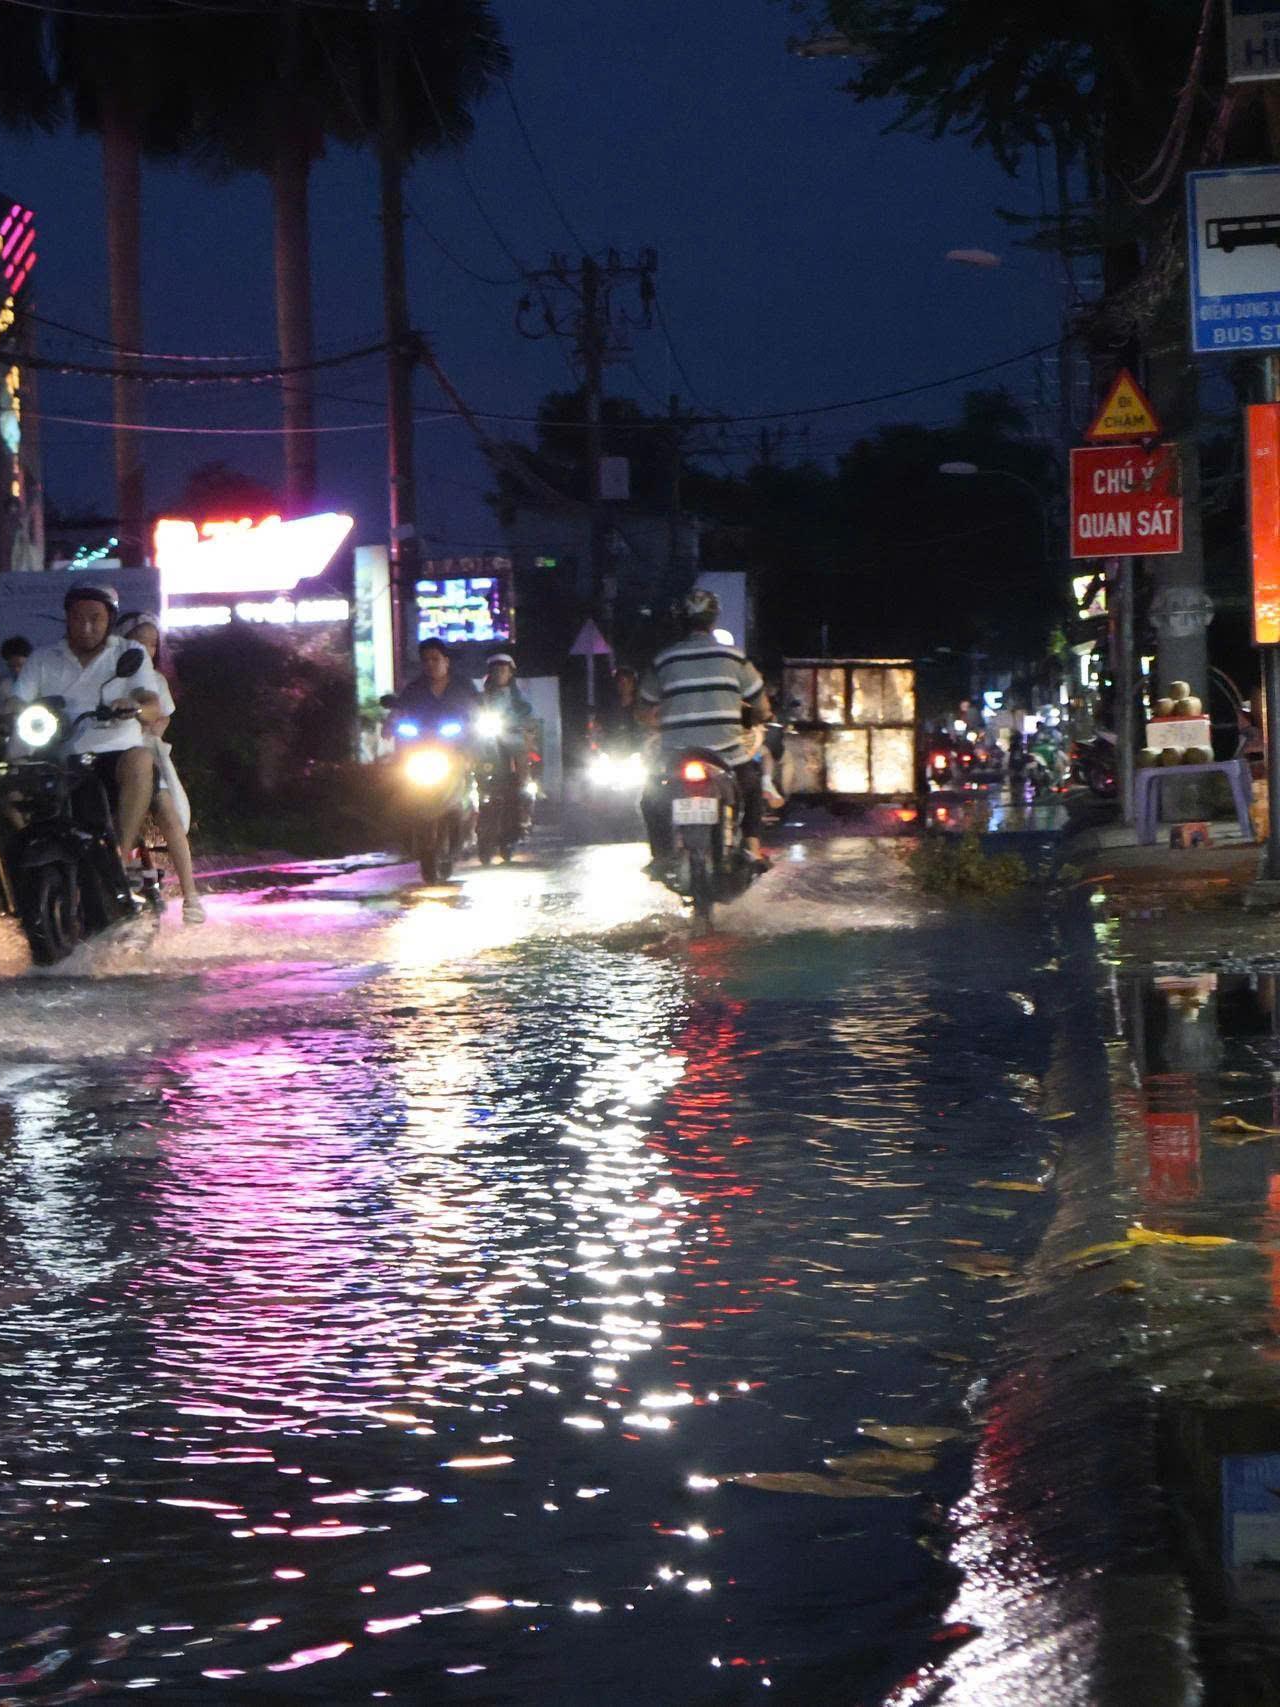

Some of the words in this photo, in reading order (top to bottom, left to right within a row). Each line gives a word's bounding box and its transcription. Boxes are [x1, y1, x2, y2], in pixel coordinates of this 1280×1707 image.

[1213, 326, 1255, 343] BUS
[1093, 460, 1133, 494] CHÚ
[1079, 511, 1132, 538] QUAN
[1137, 503, 1173, 536] SÁT
